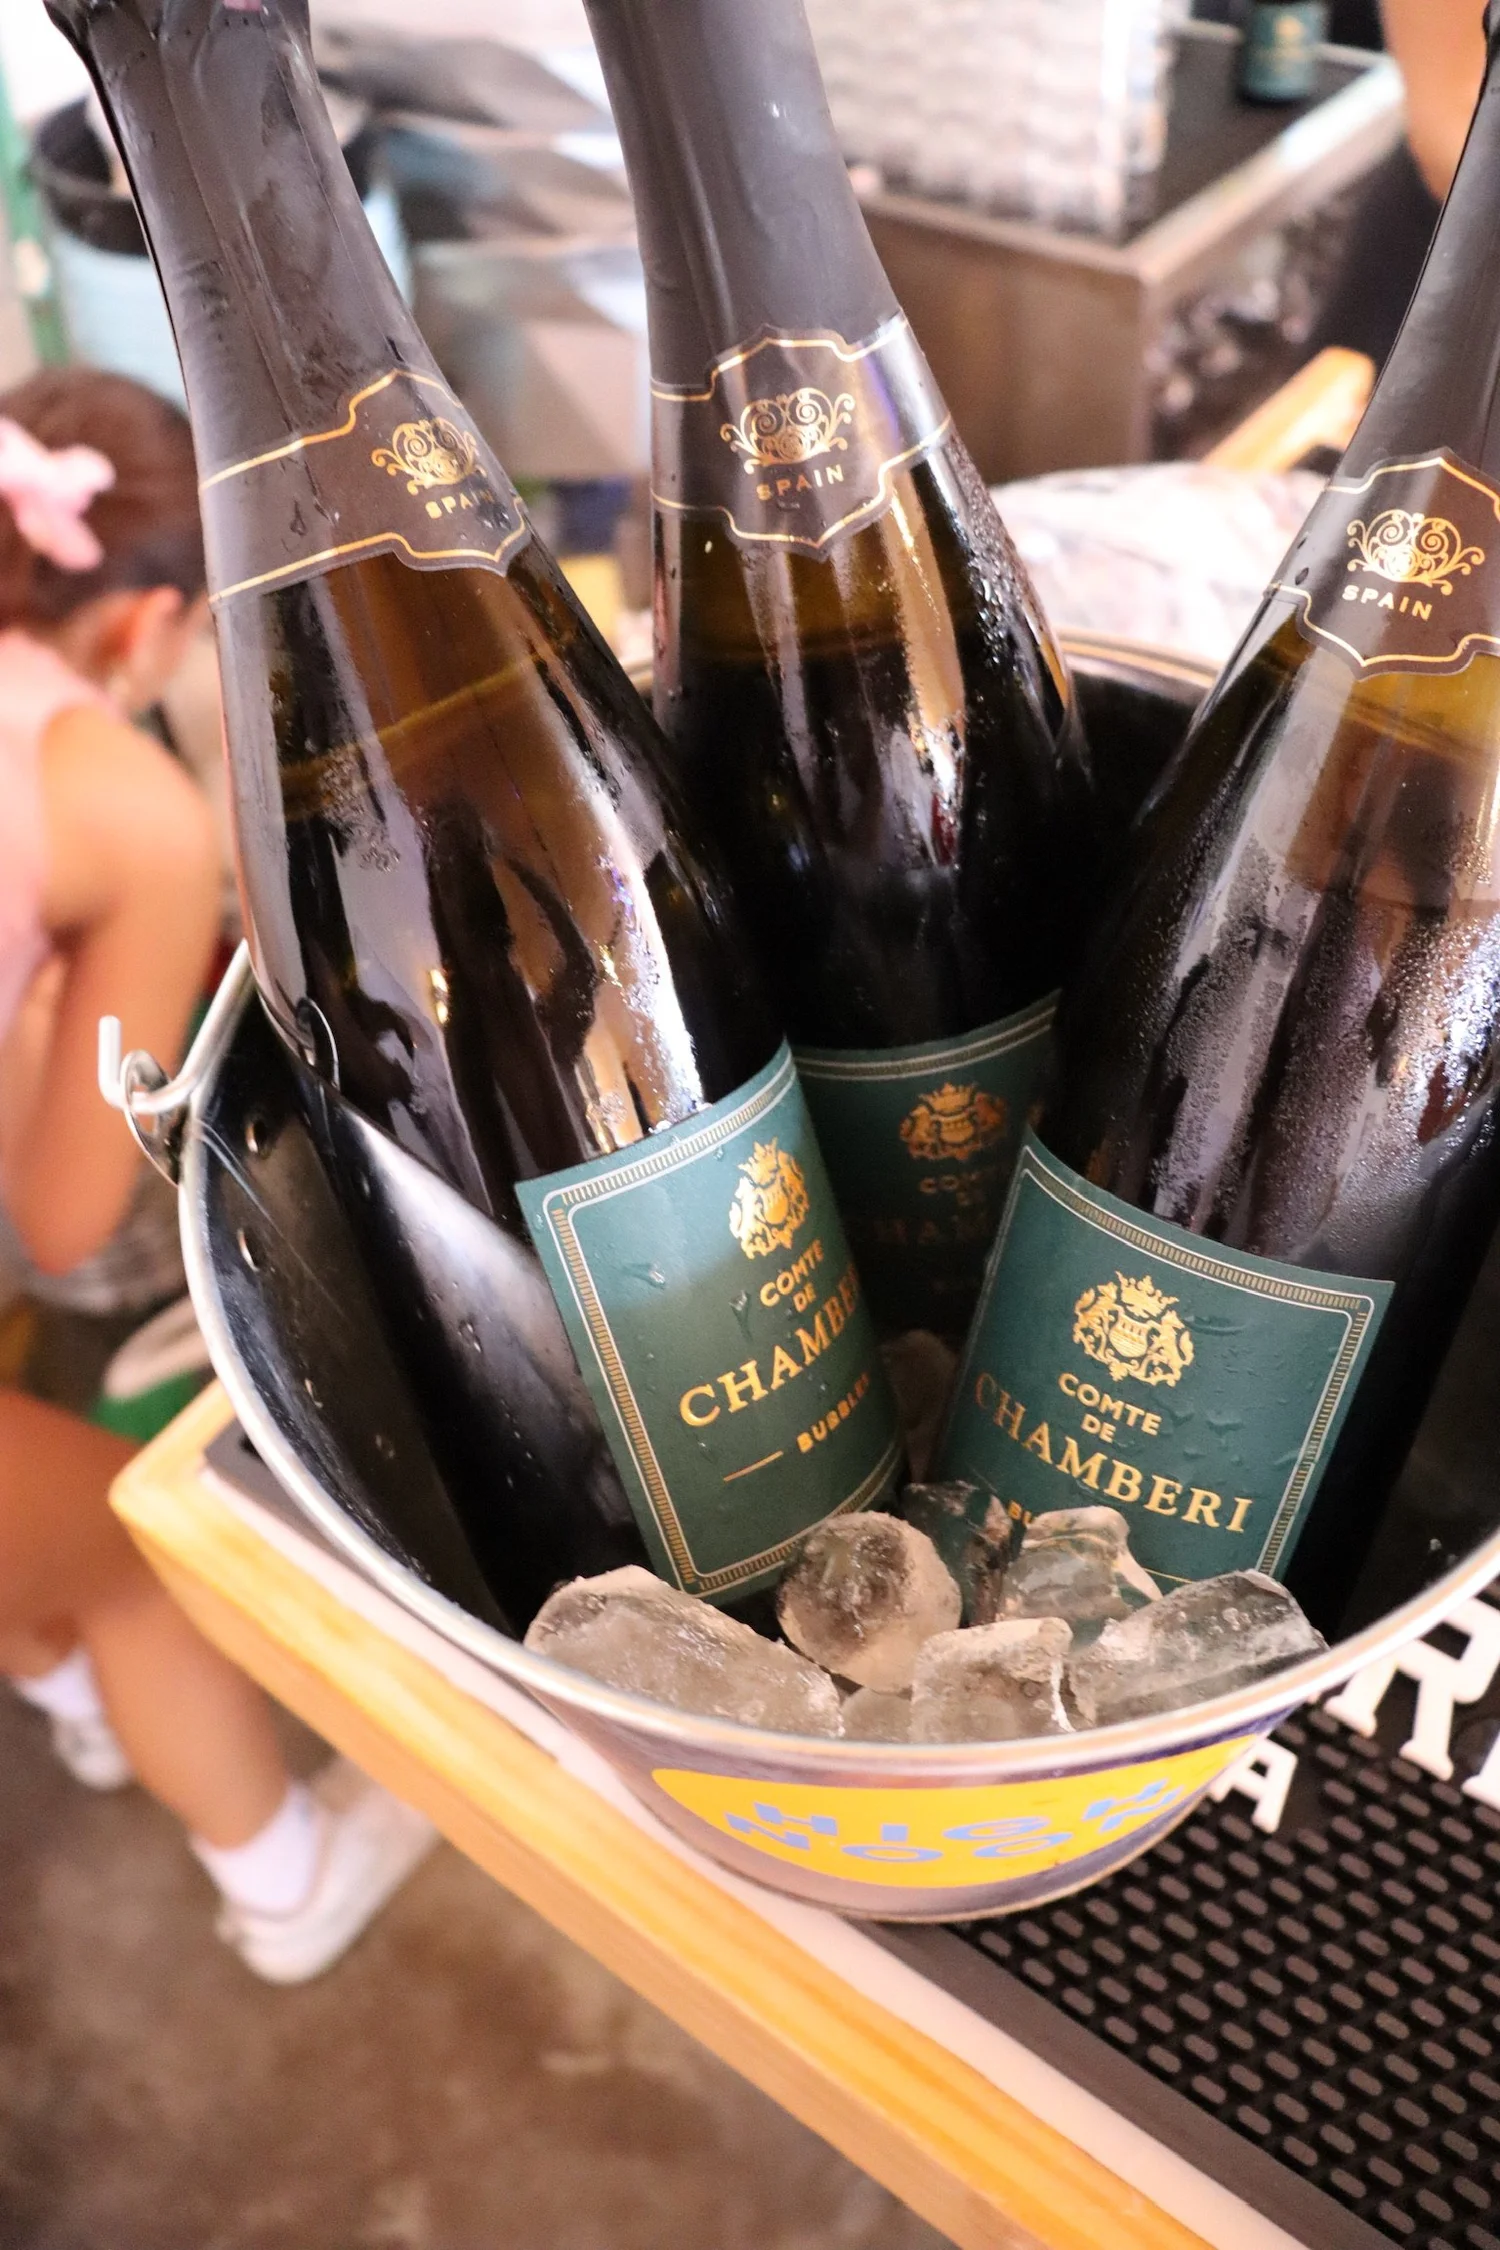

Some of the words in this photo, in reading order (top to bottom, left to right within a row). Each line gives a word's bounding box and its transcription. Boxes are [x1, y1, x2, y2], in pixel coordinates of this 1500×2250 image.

[753, 464, 845, 501] SPAIN
[1342, 585, 1433, 622] SPAIN
[760, 1239, 824, 1307] COMTE
[792, 1282, 816, 1312] DE
[1058, 1373, 1162, 1436] COMTE
[1081, 1413, 1116, 1444] DE
[974, 1372, 1253, 1533] CHAMBERI
[753, 1778, 1168, 1841] HIGH
